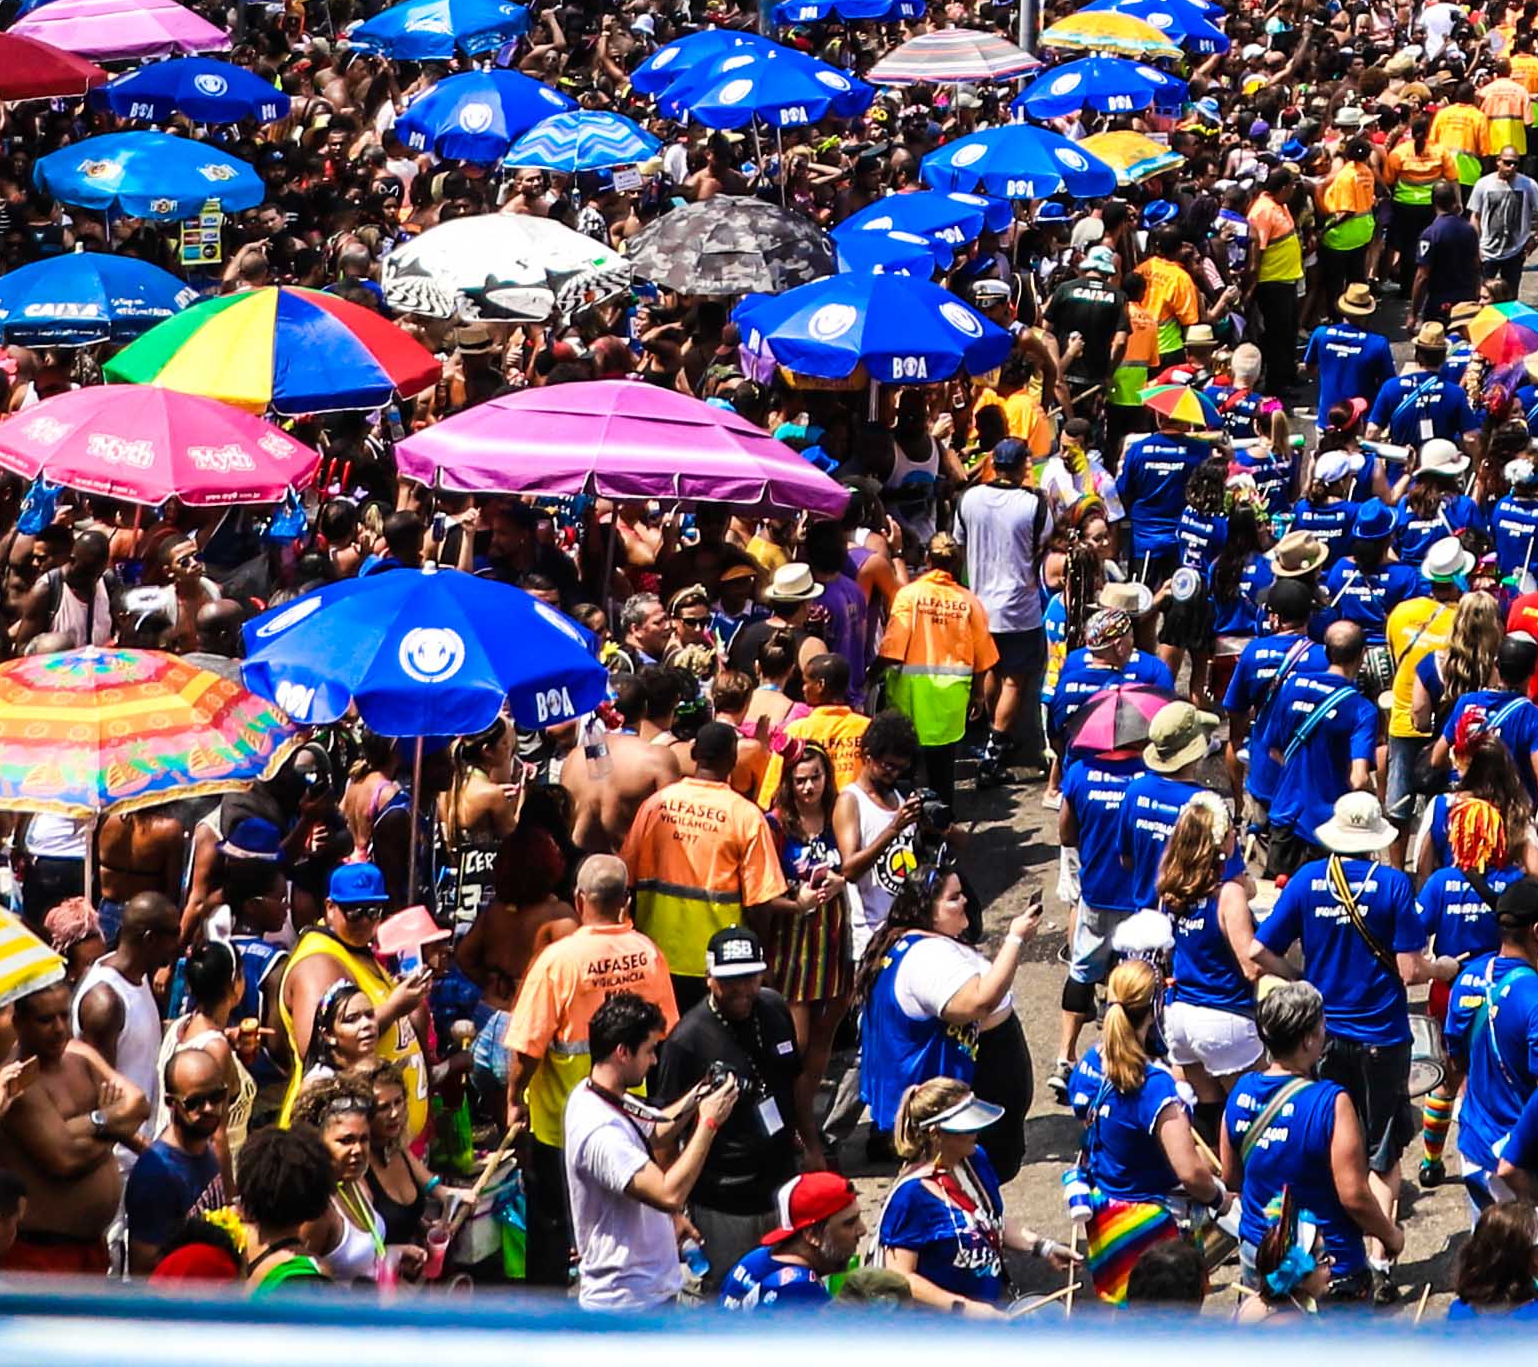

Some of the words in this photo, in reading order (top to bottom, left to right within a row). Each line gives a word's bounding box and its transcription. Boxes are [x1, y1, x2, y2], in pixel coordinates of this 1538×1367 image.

[780, 106, 808, 125] BOA
[1006, 180, 1036, 200] BOA
[1073, 288, 1115, 304] CAIXA
[24, 302, 103, 319] CAIXA
[892, 356, 928, 379] BOA
[86, 434, 156, 470] Myth
[188, 444, 257, 473] Myth
[916, 597, 967, 612] ALFASEG
[536, 686, 575, 723] BOA
[657, 799, 727, 824] ALFASEG
[587, 951, 650, 976] ALFASEG
